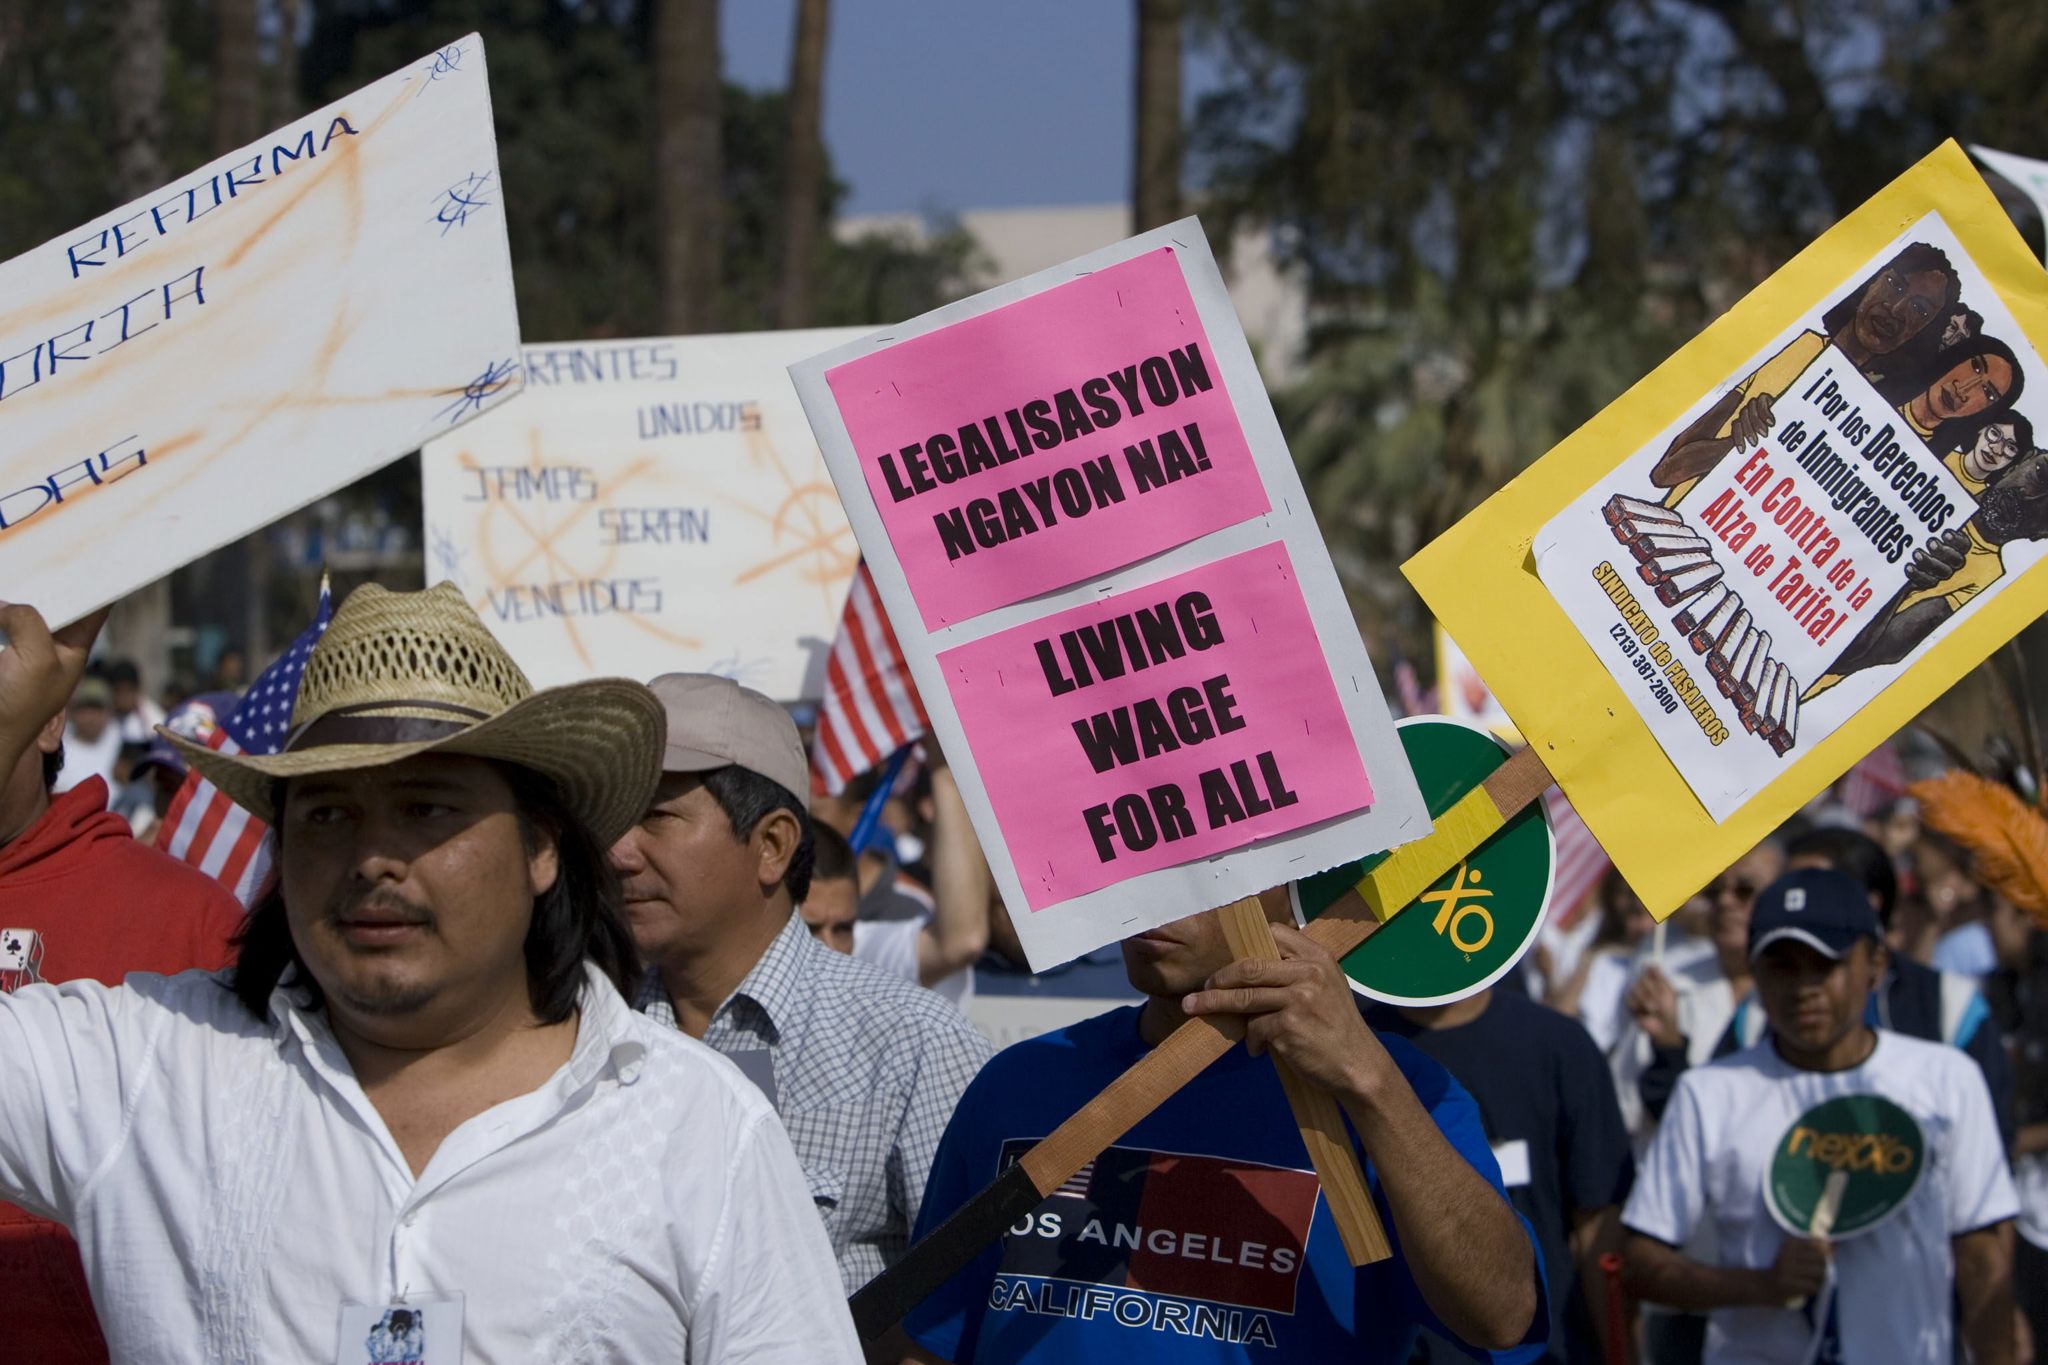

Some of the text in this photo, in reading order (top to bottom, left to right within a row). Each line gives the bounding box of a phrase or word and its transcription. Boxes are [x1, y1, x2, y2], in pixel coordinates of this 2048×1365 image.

[66, 116, 360, 279] REFORMA
[0, 266, 205, 400] ORIA
[525, 344, 678, 386] RANTES
[636, 400, 761, 440] UNIDOS
[878, 342, 1214, 503] LEGALISASYON
[1837, 406, 1872, 446] los
[1860, 423, 1955, 533] Derechos
[0, 435, 148, 530] DAS
[462, 466, 598, 502] JAMAS
[599, 507, 710, 546] SERAN
[933, 422, 1213, 561] NGAYON NA!
[1734, 447, 1873, 612] En Contra de la
[1777, 420, 1914, 564] de Inmigrantes
[487, 577, 662, 622] VENCIDOS
[1699, 488, 1848, 647] Alza de Tarifa!
[1033, 591, 1225, 697] LIVING
[1592, 561, 1729, 746] SINDICATO de PASAJEROS
[1609, 622, 1679, 715] (213) 387-2800
[1071, 673, 1247, 774] WAGE
[1082, 750, 1299, 863] FOR ALL
[1004, 1212, 1296, 1274] OS ANGELES
[988, 1278, 1277, 1348] CALIFORNIA
